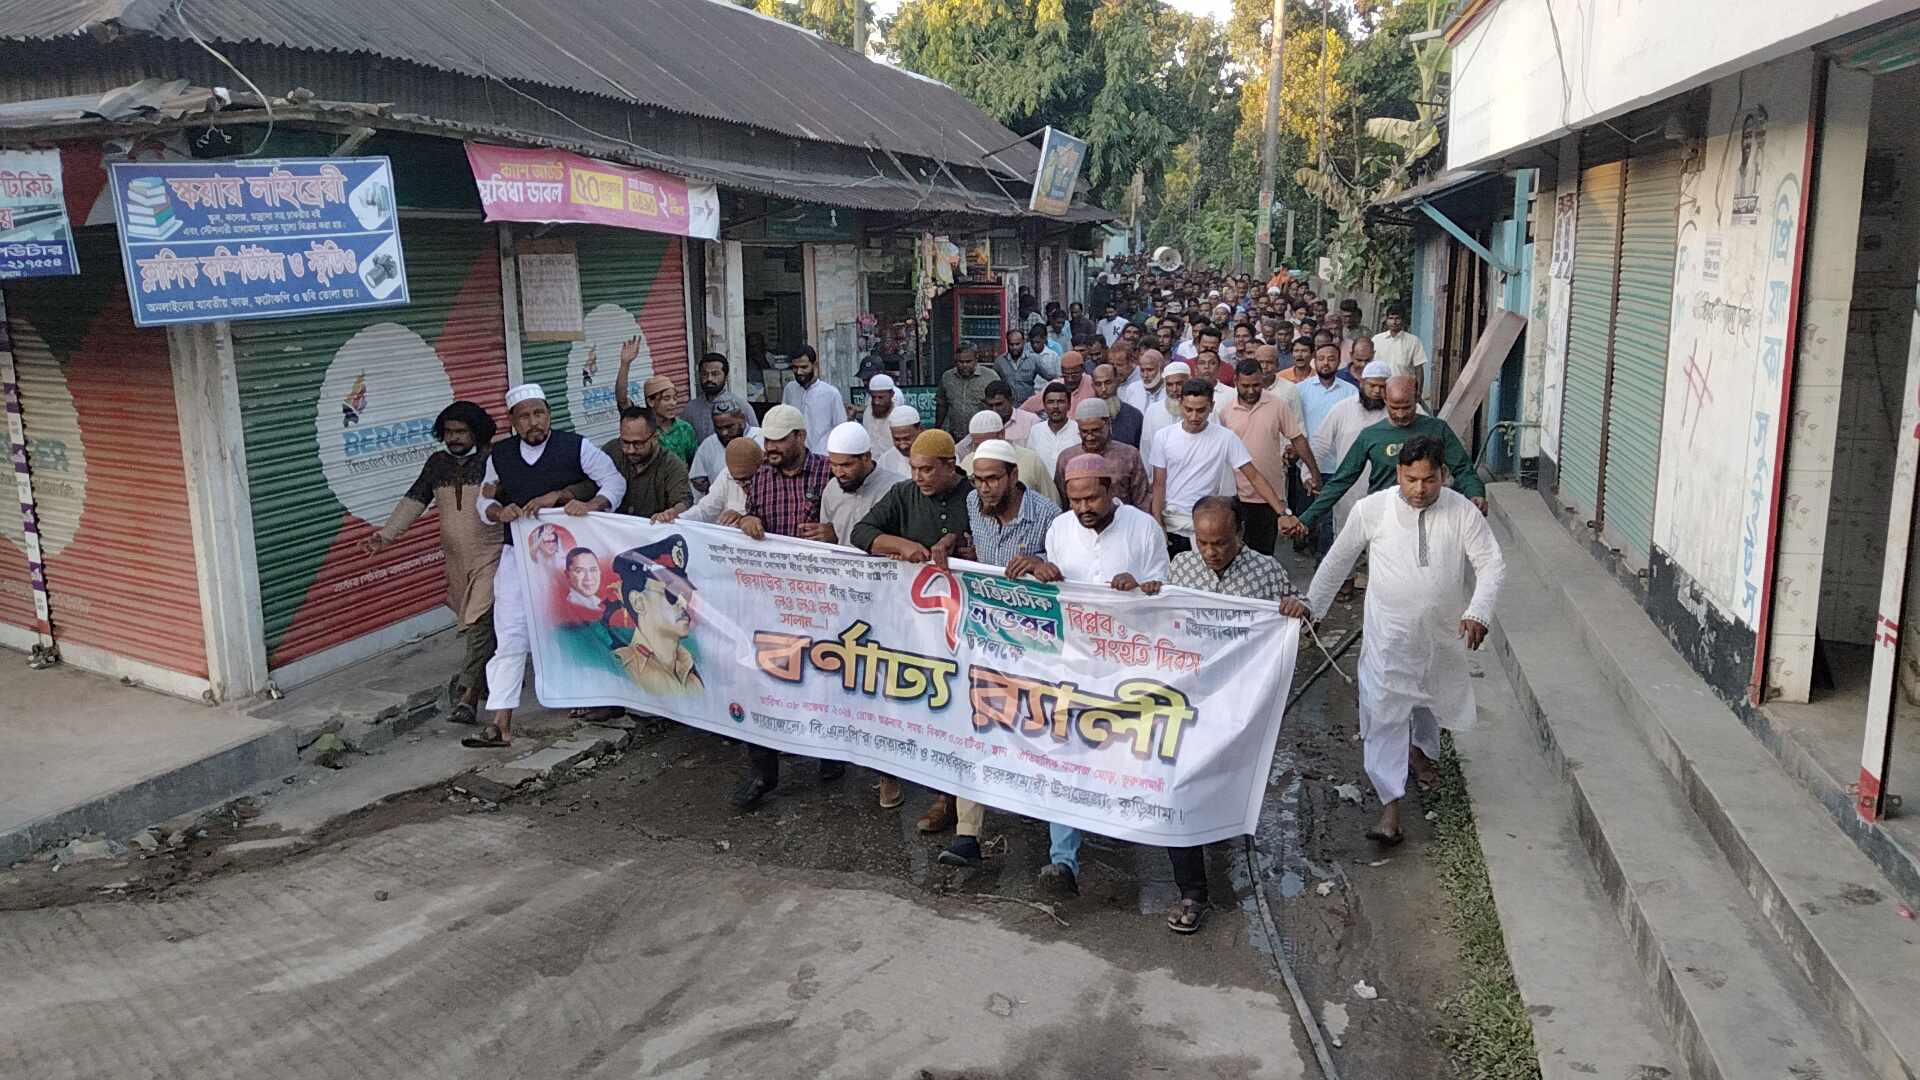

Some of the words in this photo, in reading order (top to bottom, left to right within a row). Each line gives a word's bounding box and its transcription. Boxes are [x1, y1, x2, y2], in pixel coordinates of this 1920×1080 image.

[525, 182, 564, 203] ডাবল
[136, 247, 198, 293] ক্লাসিক
[198, 243, 285, 287] কম্পিউটার
[287, 252, 304, 278] ও
[146, 299, 194, 314] অনলাইনের
[197, 295, 228, 310] যাবতীয়
[254, 291, 290, 306] ফটোকপি
[292, 294, 300, 303] ও
[302, 288, 316, 301] ছবি
[318, 288, 340, 301] তোলা
[736, 569, 783, 592] জিয়াউর
[786, 577, 827, 597] রহমান
[829, 583, 847, 600] বীর
[911, 564, 960, 653] ৭
[969, 603, 1057, 640] নভেম্বর
[1065, 602, 1114, 637] বিপ্লব
[753, 619, 959, 710] বর্ণাঢ্য
[1089, 634, 1153, 666] সংহতি
[1154, 638, 1202, 673] দিবস
[920, 748, 929, 761] ও
